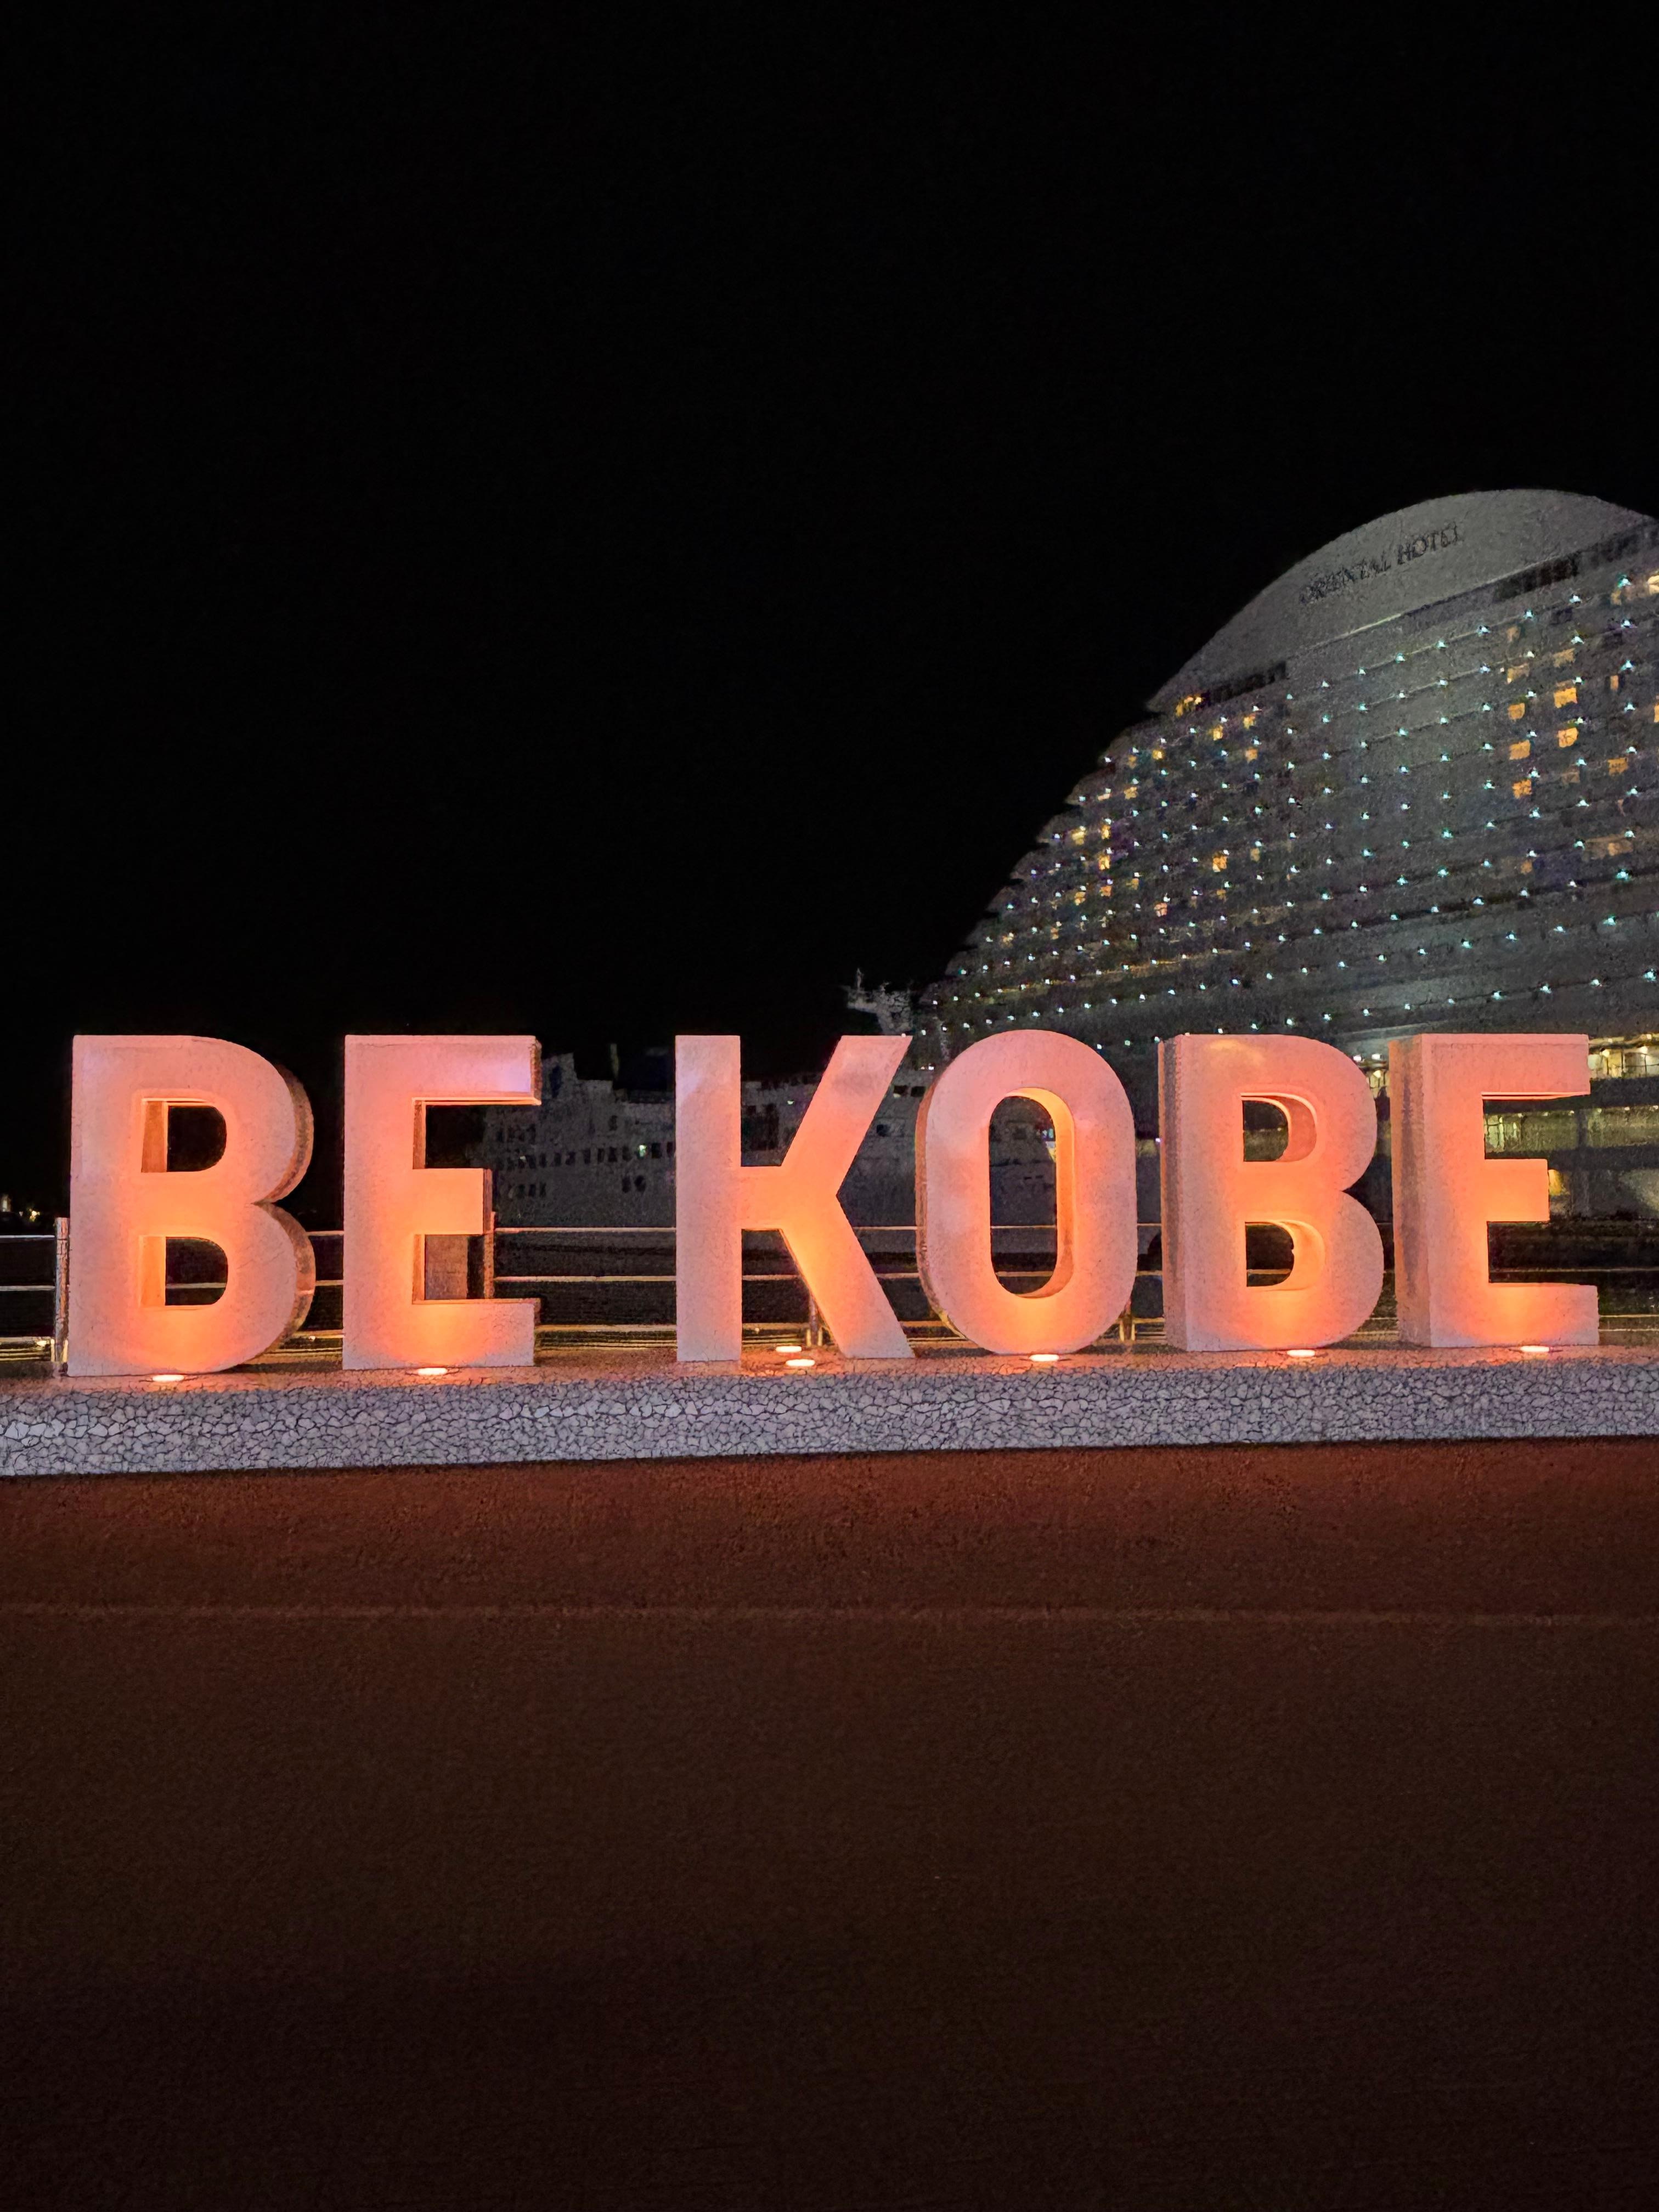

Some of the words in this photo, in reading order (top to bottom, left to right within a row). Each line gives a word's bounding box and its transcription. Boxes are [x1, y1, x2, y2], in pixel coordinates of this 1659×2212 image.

[1397, 522, 1459, 565] HOTEL
[68, 1034, 541, 1376] BE
[675, 1029, 1600, 1362] KOBE
